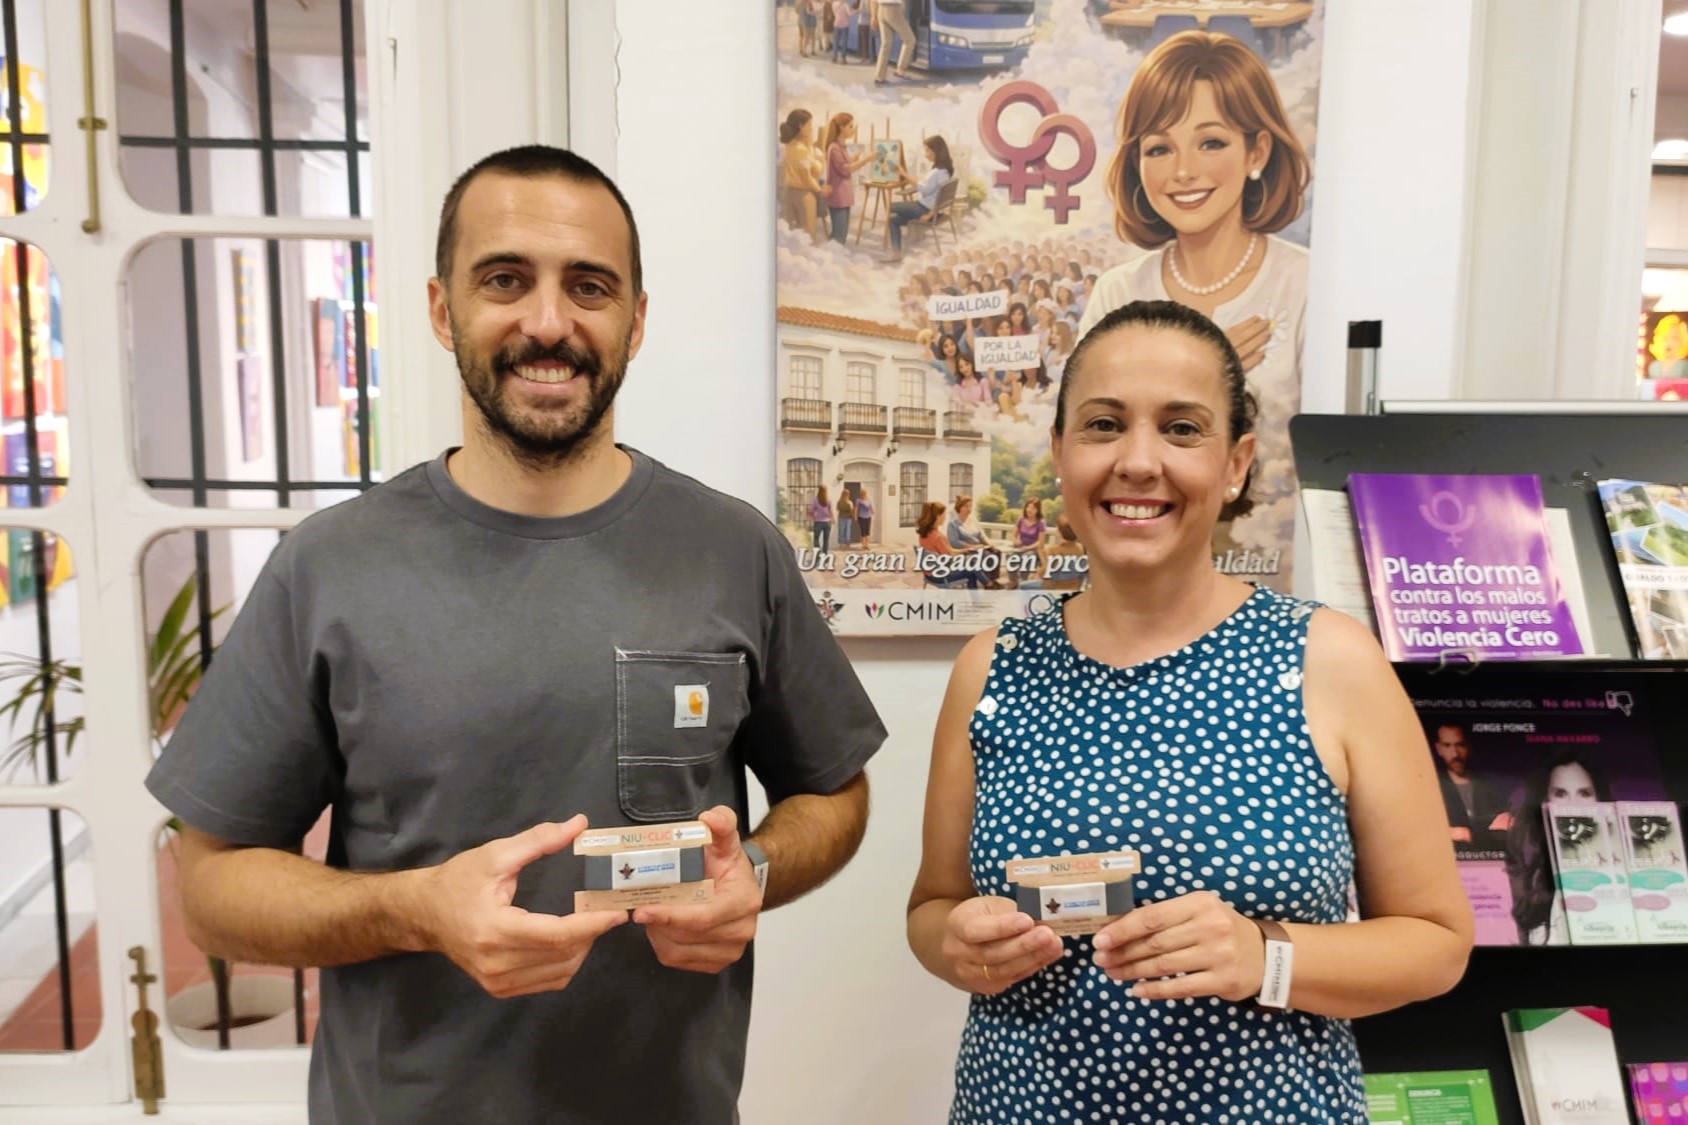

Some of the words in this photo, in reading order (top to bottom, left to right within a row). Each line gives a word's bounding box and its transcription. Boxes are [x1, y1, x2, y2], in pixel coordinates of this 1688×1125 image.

[935, 296, 1001, 315] IGUALDAD
[984, 341, 1003, 351] POR
[1008, 340, 1022, 350] LA
[980, 351, 1038, 365] IGUALDAD
[798, 547, 834, 571] Un
[841, 551, 905, 578] gran
[914, 547, 999, 578] legado
[1006, 553, 1038, 572] en
[1382, 556, 1541, 585] Plataforma
[1390, 587, 1454, 605] contra
[1455, 586, 1485, 605] los
[1488, 586, 1547, 605] malos
[888, 601, 954, 620] CMIM
[1394, 607, 1453, 625] tratos
[1456, 609, 1469, 625] a
[1471, 606, 1555, 630] mujeres
[1398, 626, 1504, 647] Violencia
[1505, 626, 1560, 647] Cero
[1542, 699, 1558, 709] No
[1561, 699, 1583, 709] des
[1472, 723, 1501, 733] JORGE
[1502, 723, 1536, 733] PONCE
[1562, 1098, 1599, 1113] CMIM
